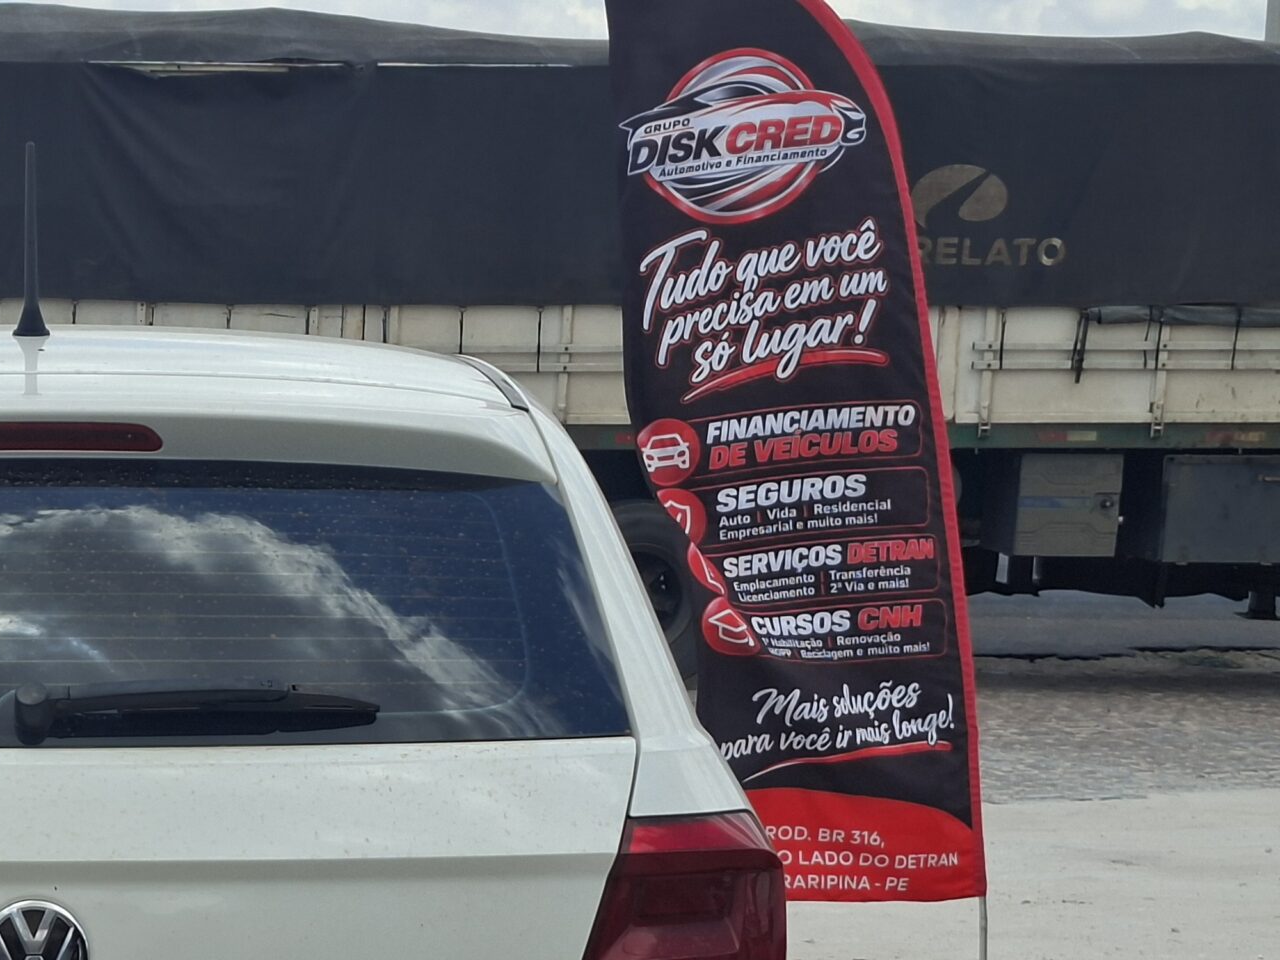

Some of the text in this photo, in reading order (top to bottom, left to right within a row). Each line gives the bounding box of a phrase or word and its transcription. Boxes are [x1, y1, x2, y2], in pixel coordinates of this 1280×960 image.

[644, 118, 690, 135] GRUPO
[658, 148, 827, 178] Automotivo e Financiamento
[640, 216, 882, 331] Tudo que você
[657, 269, 888, 366] precisa em um
[691, 299, 877, 384] só lugar!
[706, 404, 916, 445] FINANCIAMENTO
[708, 428, 899, 470] DE VEÍCULOS
[715, 473, 867, 513] SEGUROS
[719, 499, 892, 528] Auto Vida Residencial
[719, 513, 878, 541] Empresarial e muito mais!
[723, 538, 934, 578] SERVIÇOS DETRAN
[733, 565, 911, 593] Emplacamento Transferência
[845, 580, 865, 592] Via
[867, 582, 875, 591] e
[878, 578, 909, 589] mais!
[751, 605, 923, 636] CURSOS CNH
[837, 632, 902, 646] Renovação
[856, 649, 863, 657] e
[867, 646, 900, 656] muito
[903, 642, 930, 653] mais!
[752, 680, 922, 726] Mais soluções
[720, 694, 955, 760] para você ir mais longe!
[765, 825, 885, 848] ROD. BR 316,
[798, 850, 854, 866] LADO
[859, 853, 889, 868] DO
[894, 852, 959, 869] DETRAN
[784, 874, 870, 890] RARIPINA
[885, 876, 909, 891] PE
